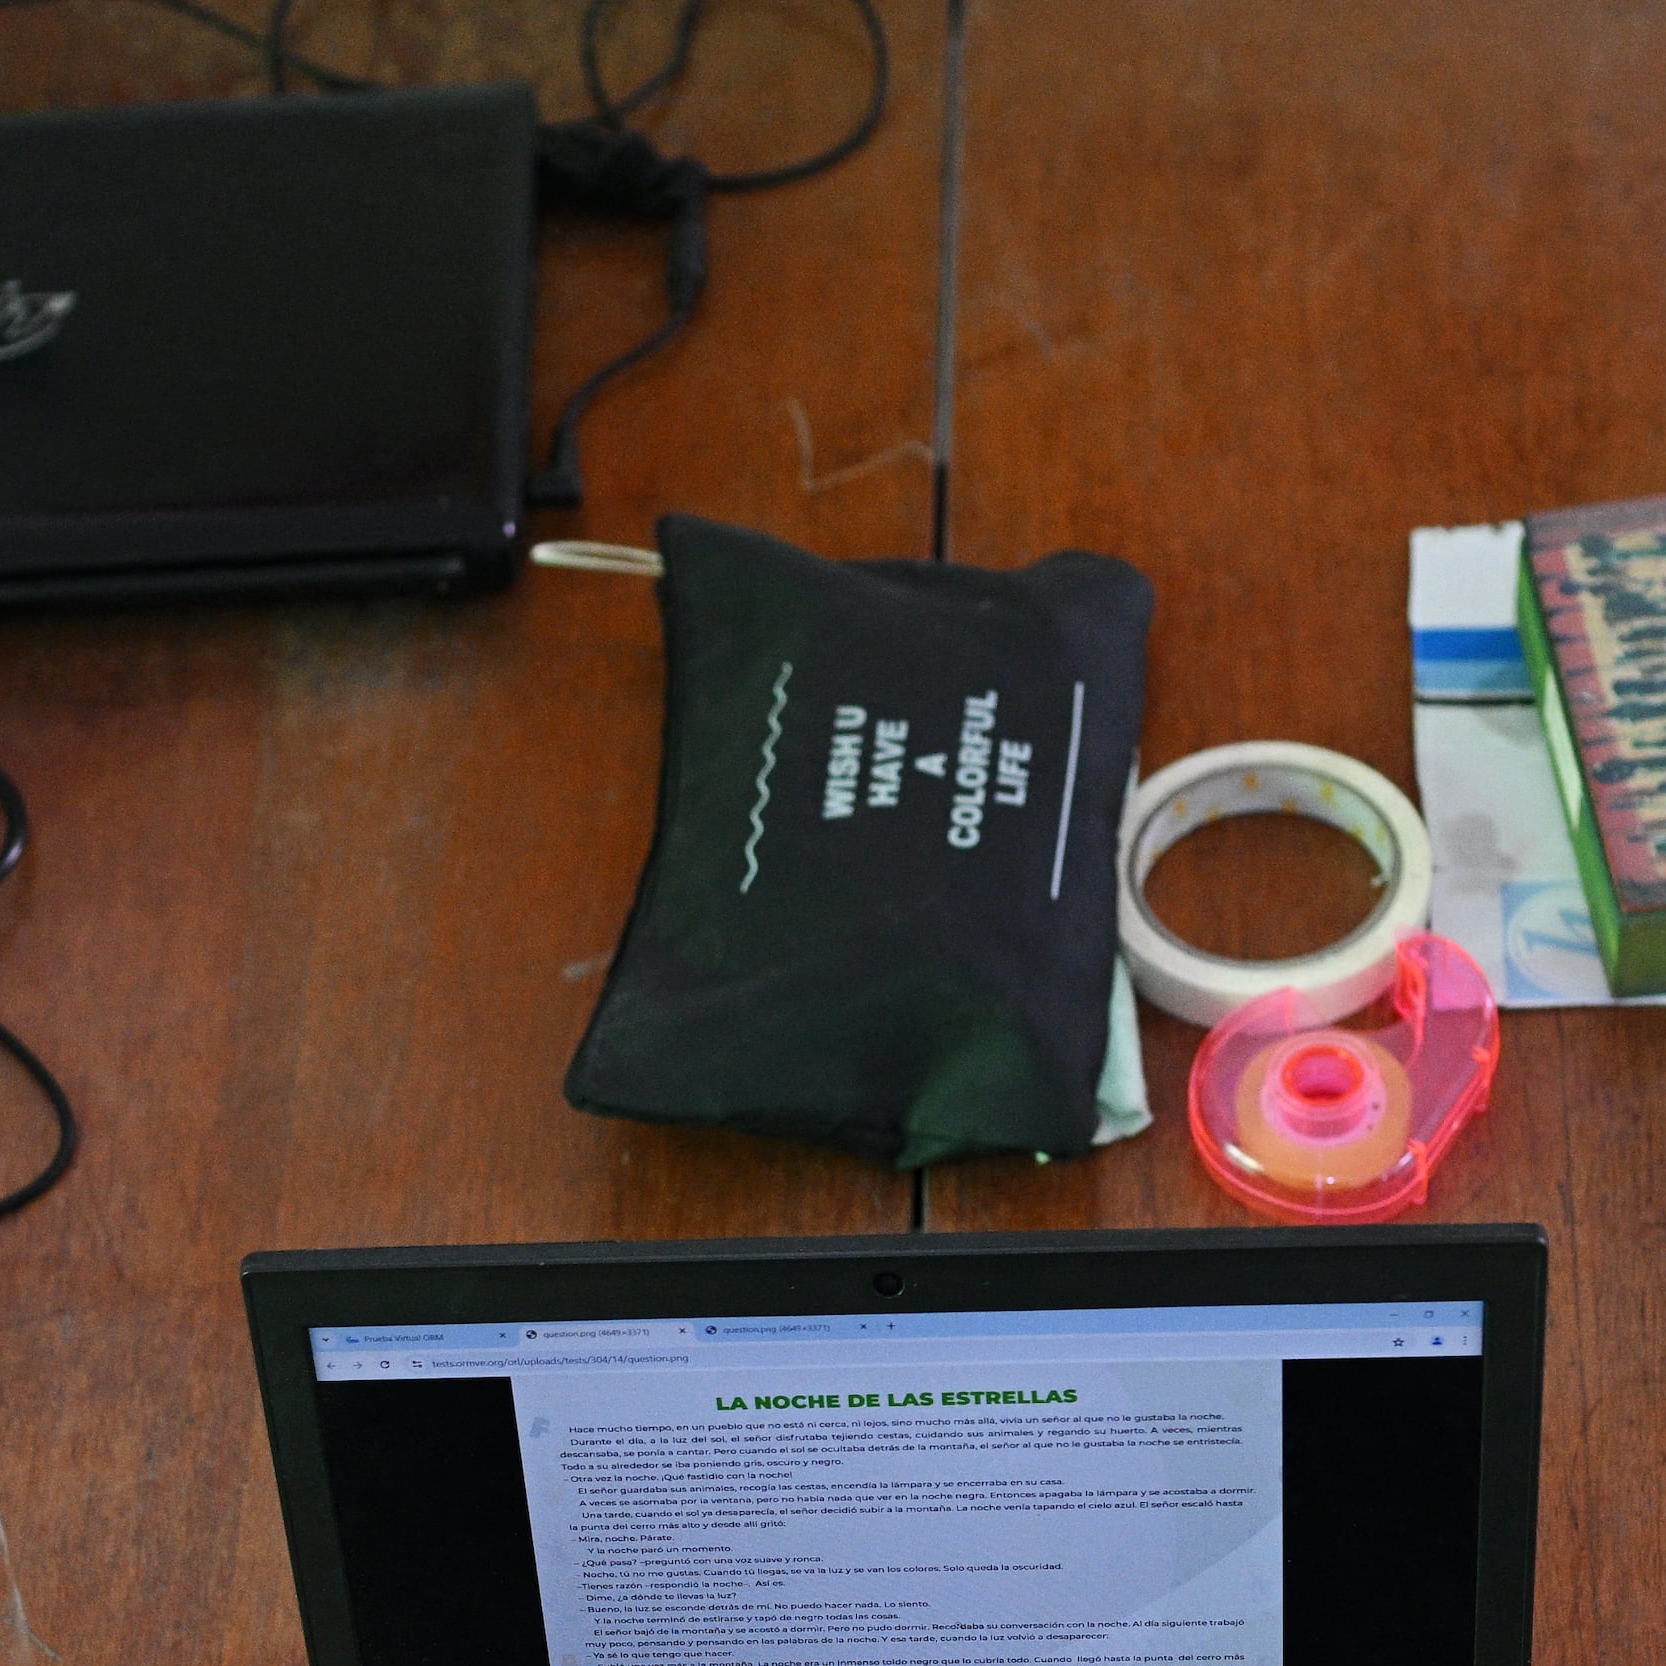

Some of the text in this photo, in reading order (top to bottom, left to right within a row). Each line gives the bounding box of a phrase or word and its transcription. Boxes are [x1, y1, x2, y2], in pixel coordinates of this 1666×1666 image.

[821, 704, 868, 820] WISH U
[867, 719, 910, 807] HAVE
[914, 752, 948, 778] A
[946, 689, 999, 849] COLORFUL
[994, 740, 1033, 808] LIFE
[715, 1389, 1077, 1410] LA NOCHE DE LAS ESTRELLAS
